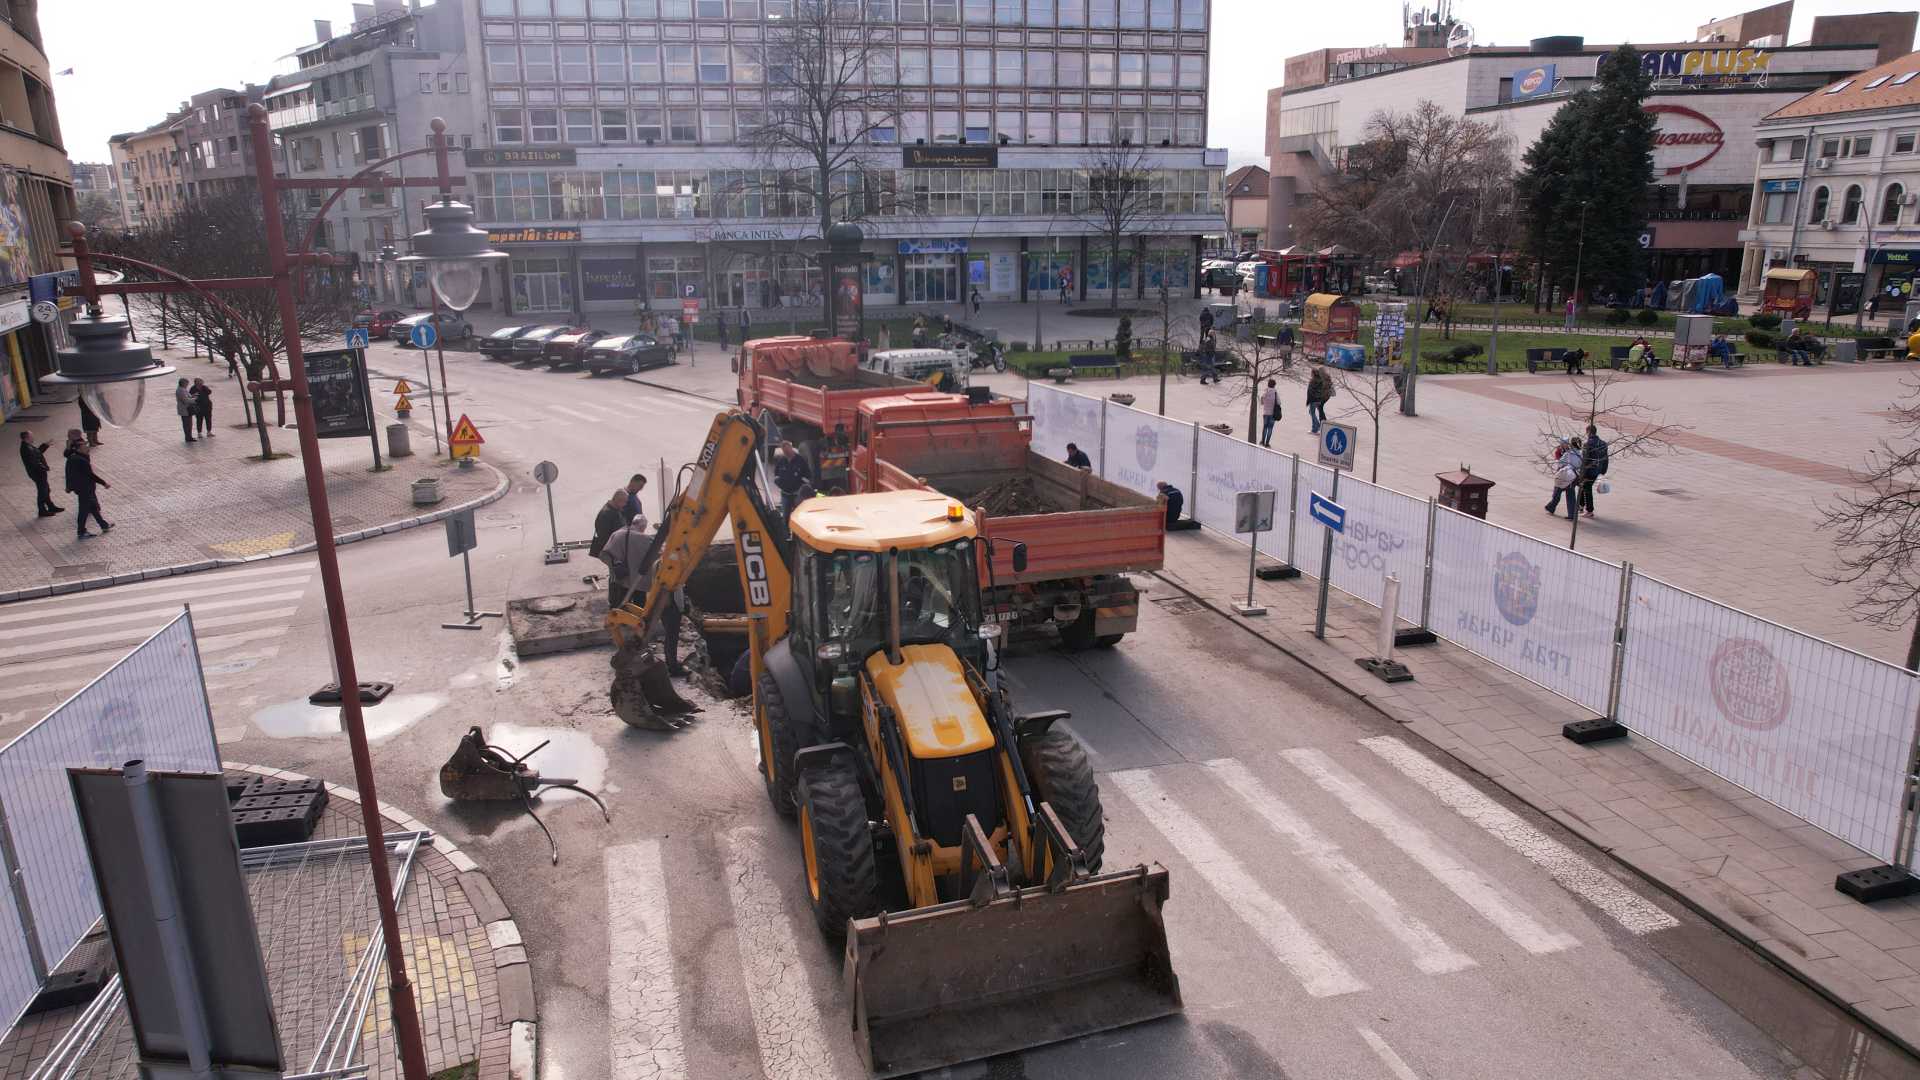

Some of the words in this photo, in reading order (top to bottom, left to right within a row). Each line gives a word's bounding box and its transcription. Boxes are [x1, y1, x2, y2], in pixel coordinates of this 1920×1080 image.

[1684, 49, 1755, 75] PLUS
[1523, 76, 1541, 87] PEPCO
[1689, 76, 1718, 84] market
[1719, 75, 1743, 83] store
[714, 230, 749, 241] BANCA
[750, 229, 785, 240] INTESA
[931, 238, 950, 252] lilly
[685, 285, 695, 297] P
[37, 305, 52, 313] 24
[741, 533, 772, 606] JCB
